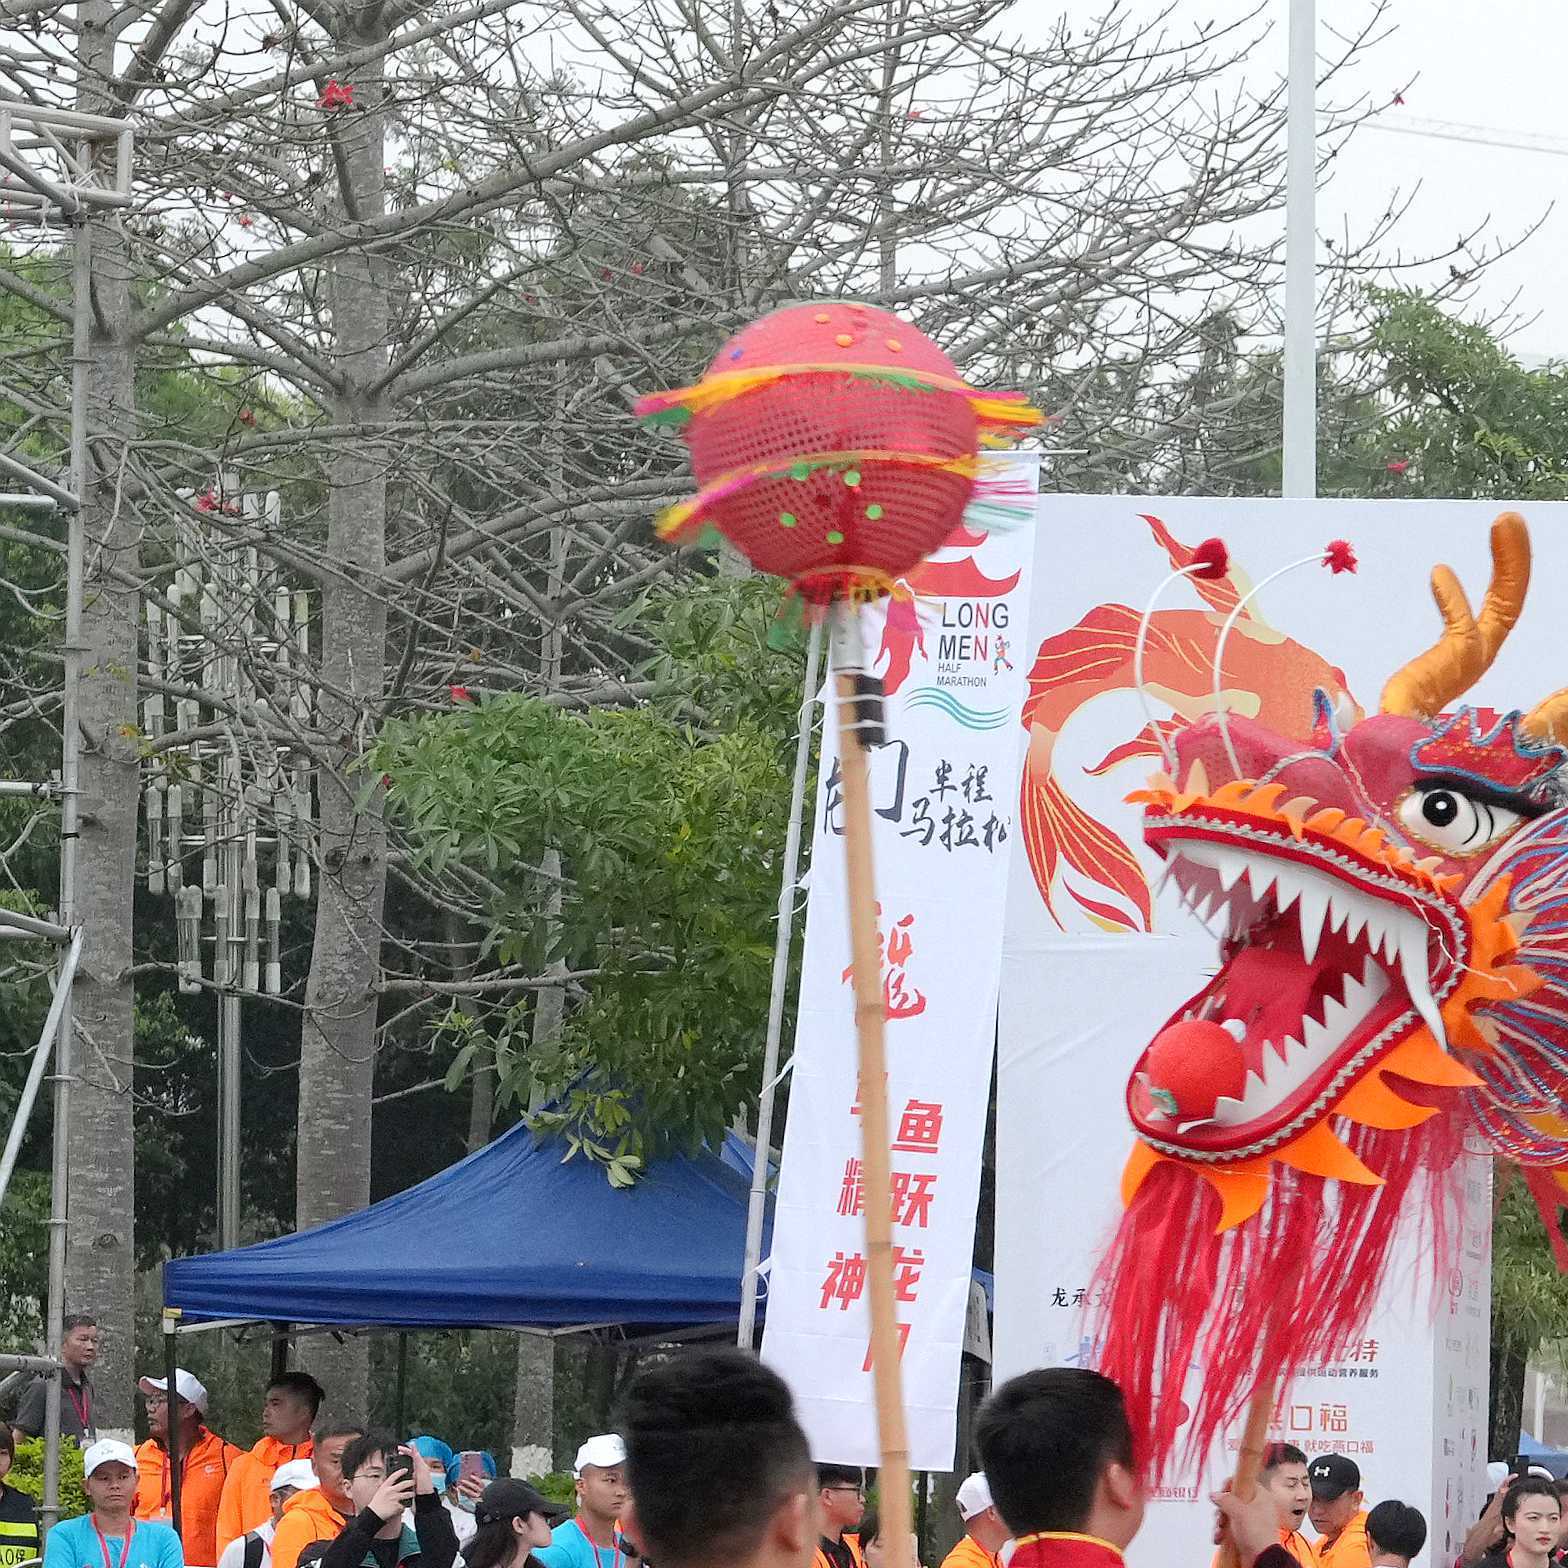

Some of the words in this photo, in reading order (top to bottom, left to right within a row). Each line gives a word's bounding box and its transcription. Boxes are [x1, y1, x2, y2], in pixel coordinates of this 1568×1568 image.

[941, 602, 1010, 630] LONG
[937, 633, 989, 662] MEN
[936, 676, 988, 688] MARATHON
[937, 663, 962, 674] HALF
[927, 757, 994, 805] 半程
